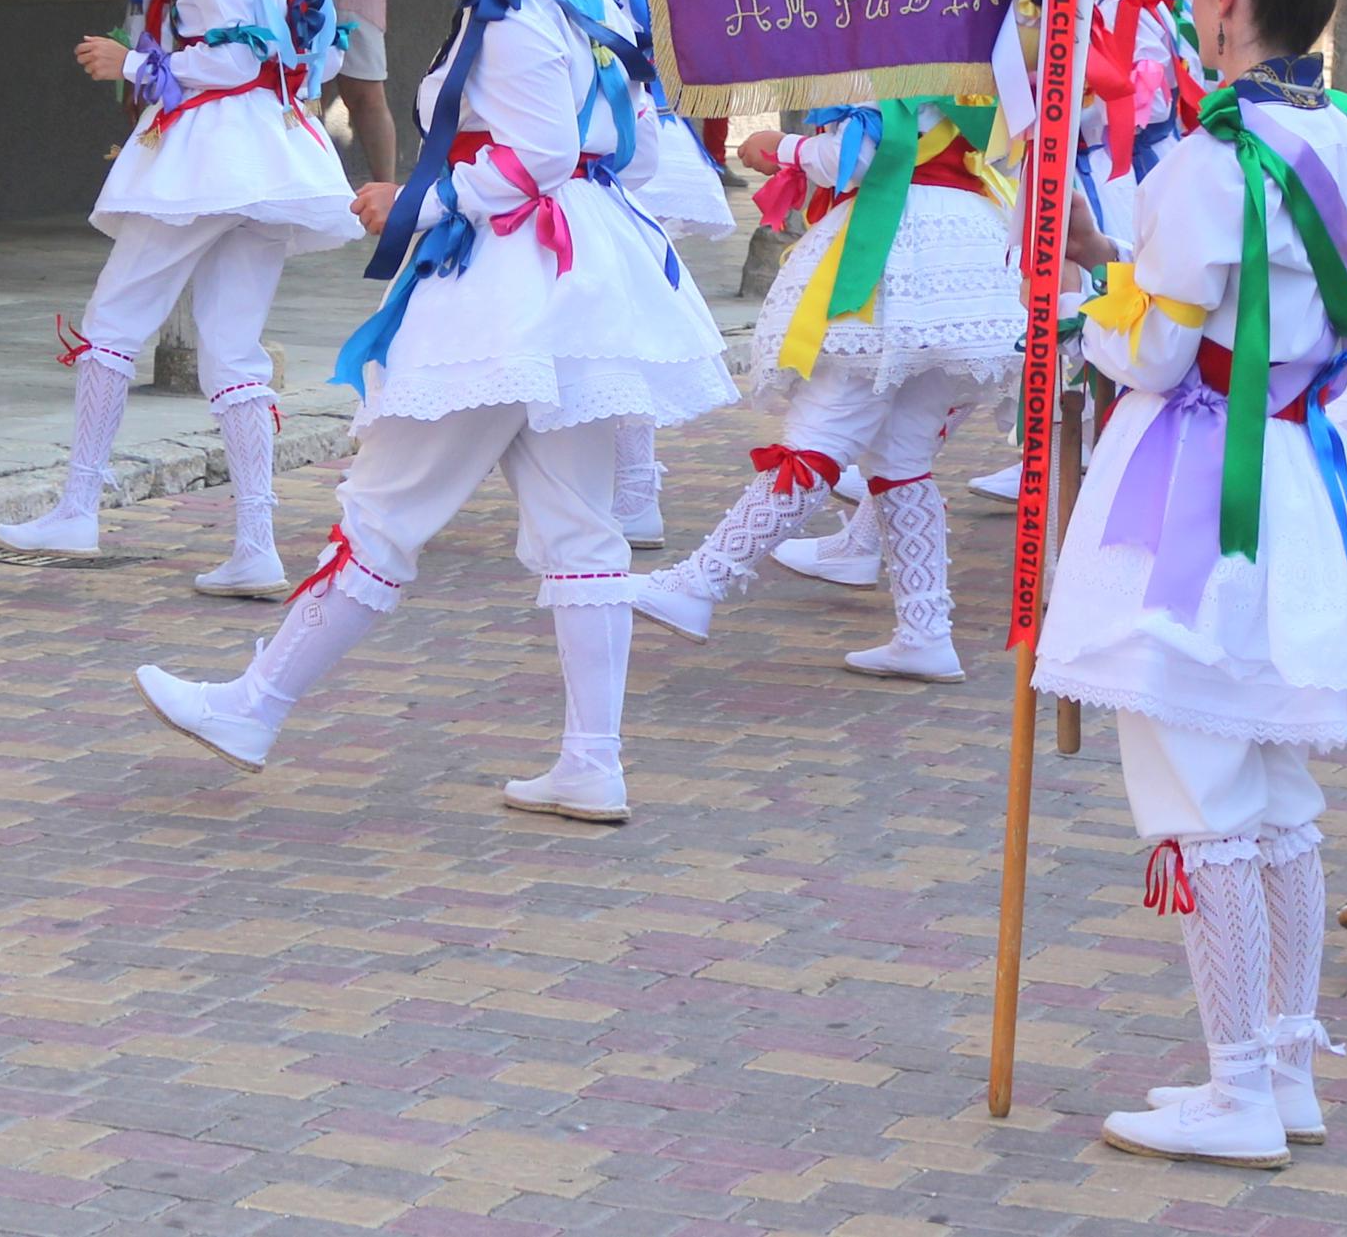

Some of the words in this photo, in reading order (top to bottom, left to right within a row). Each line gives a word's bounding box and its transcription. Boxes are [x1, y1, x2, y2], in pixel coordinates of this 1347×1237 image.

[1042, 136, 1058, 164] DE
[1035, 177, 1059, 278] DANZAS
[1023, 292, 1051, 496] TRADICIONALES
[1018, 506, 1041, 628] 24/07/2010
